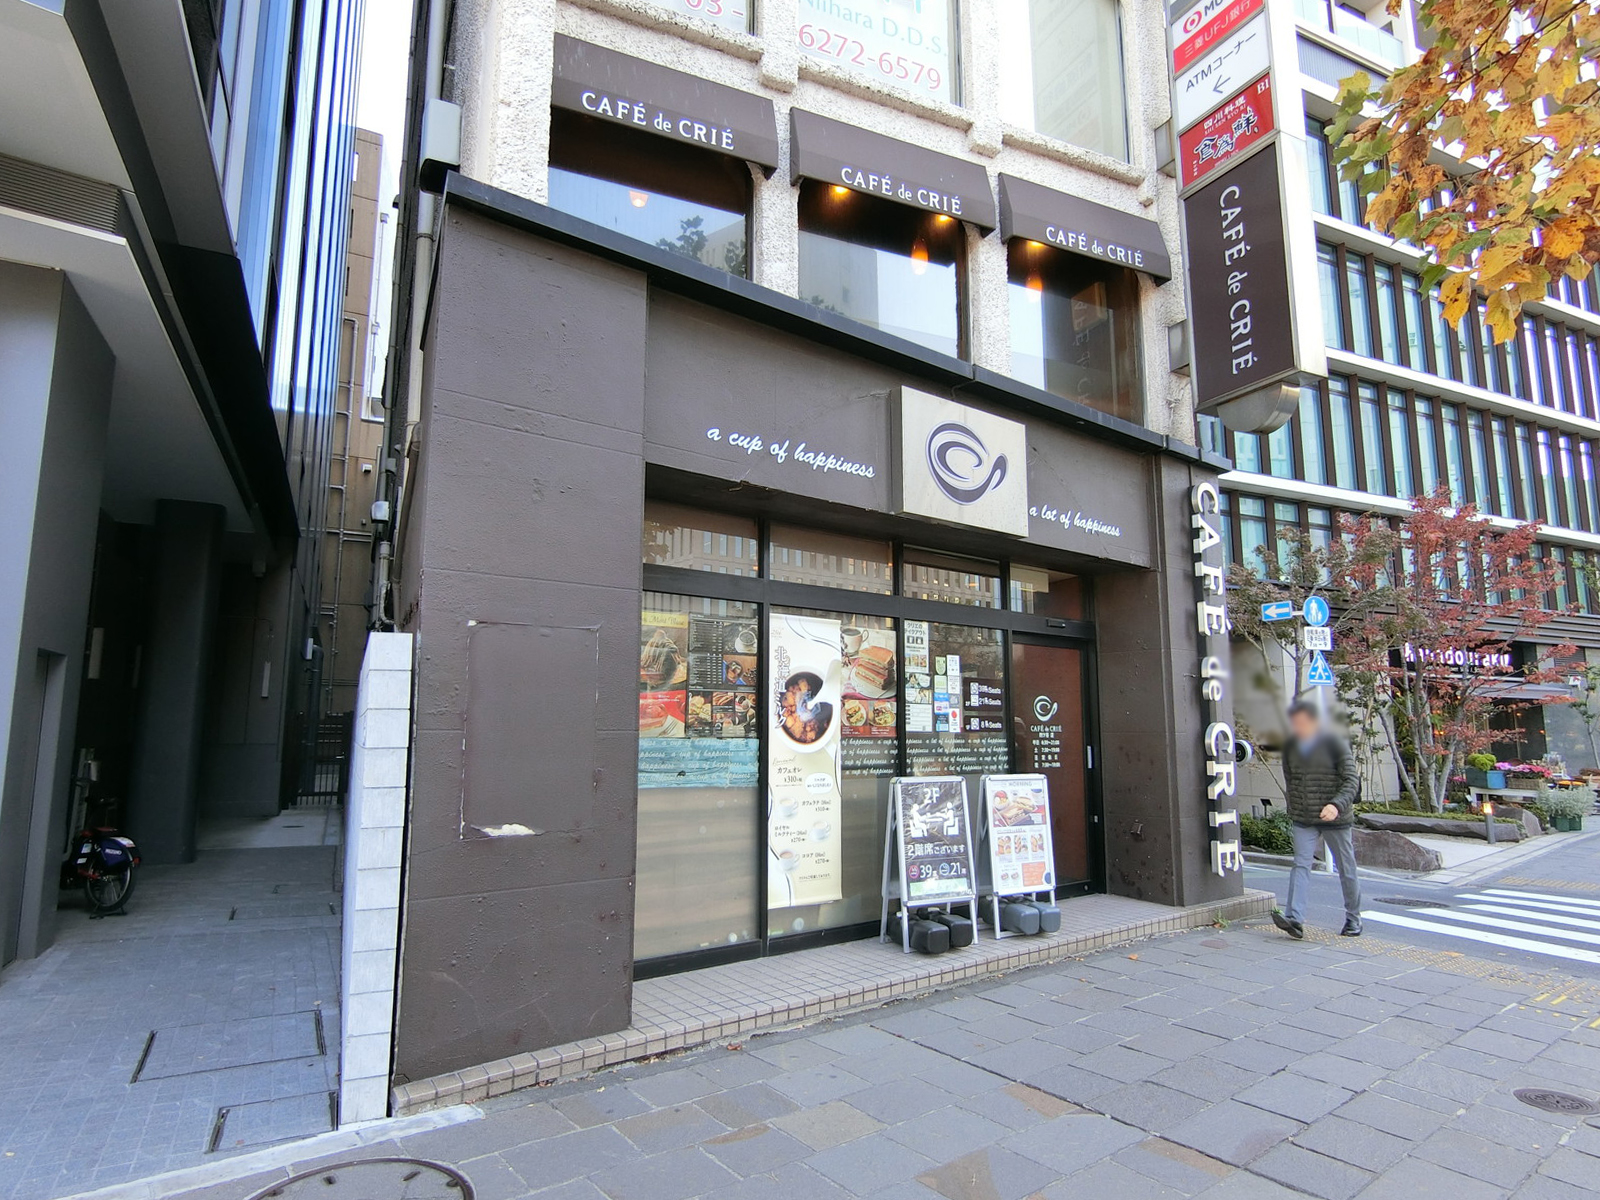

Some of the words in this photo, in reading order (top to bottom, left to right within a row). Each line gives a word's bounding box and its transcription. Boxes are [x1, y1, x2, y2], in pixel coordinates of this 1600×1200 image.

[799, 24, 940, 90] 6272-6579
[1186, 33, 1256, 93] ATMコーナー
[581, 92, 647, 125] CAFÉ
[654, 113, 672, 133] de
[678, 120, 735, 150] CRIÉ
[1203, 94, 1246, 129] 四川料理
[841, 168, 893, 196] CAFÉ
[898, 183, 912, 201] de
[917, 189, 963, 215] CRIÉ
[1045, 226, 1087, 252] CAFÉ
[1092, 240, 1104, 256] de
[1107, 245, 1143, 267] CRIÉ
[1220, 185, 1252, 266] CAFÉ
[1227, 271, 1248, 296] de
[1228, 299, 1258, 375] CRIÉ
[707, 426, 722, 441] a
[729, 431, 763, 454] cup
[769, 438, 790, 463] of
[793, 442, 876, 479] happiness
[1029, 506, 1038, 517] a
[1040, 503, 1056, 521] lot
[1058, 509, 1071, 529] of
[1072, 512, 1121, 538] happiness
[1191, 482, 1233, 637] CAFÉ
[1201, 656, 1230, 702] de
[1030, 724, 1044, 733] CAFÉ
[777, 766, 803, 774] カフェオレ
[923, 787, 940, 804] 2F
[1204, 721, 1246, 878] CRIÉ
[907, 842, 966, 857] 2階席ございます
